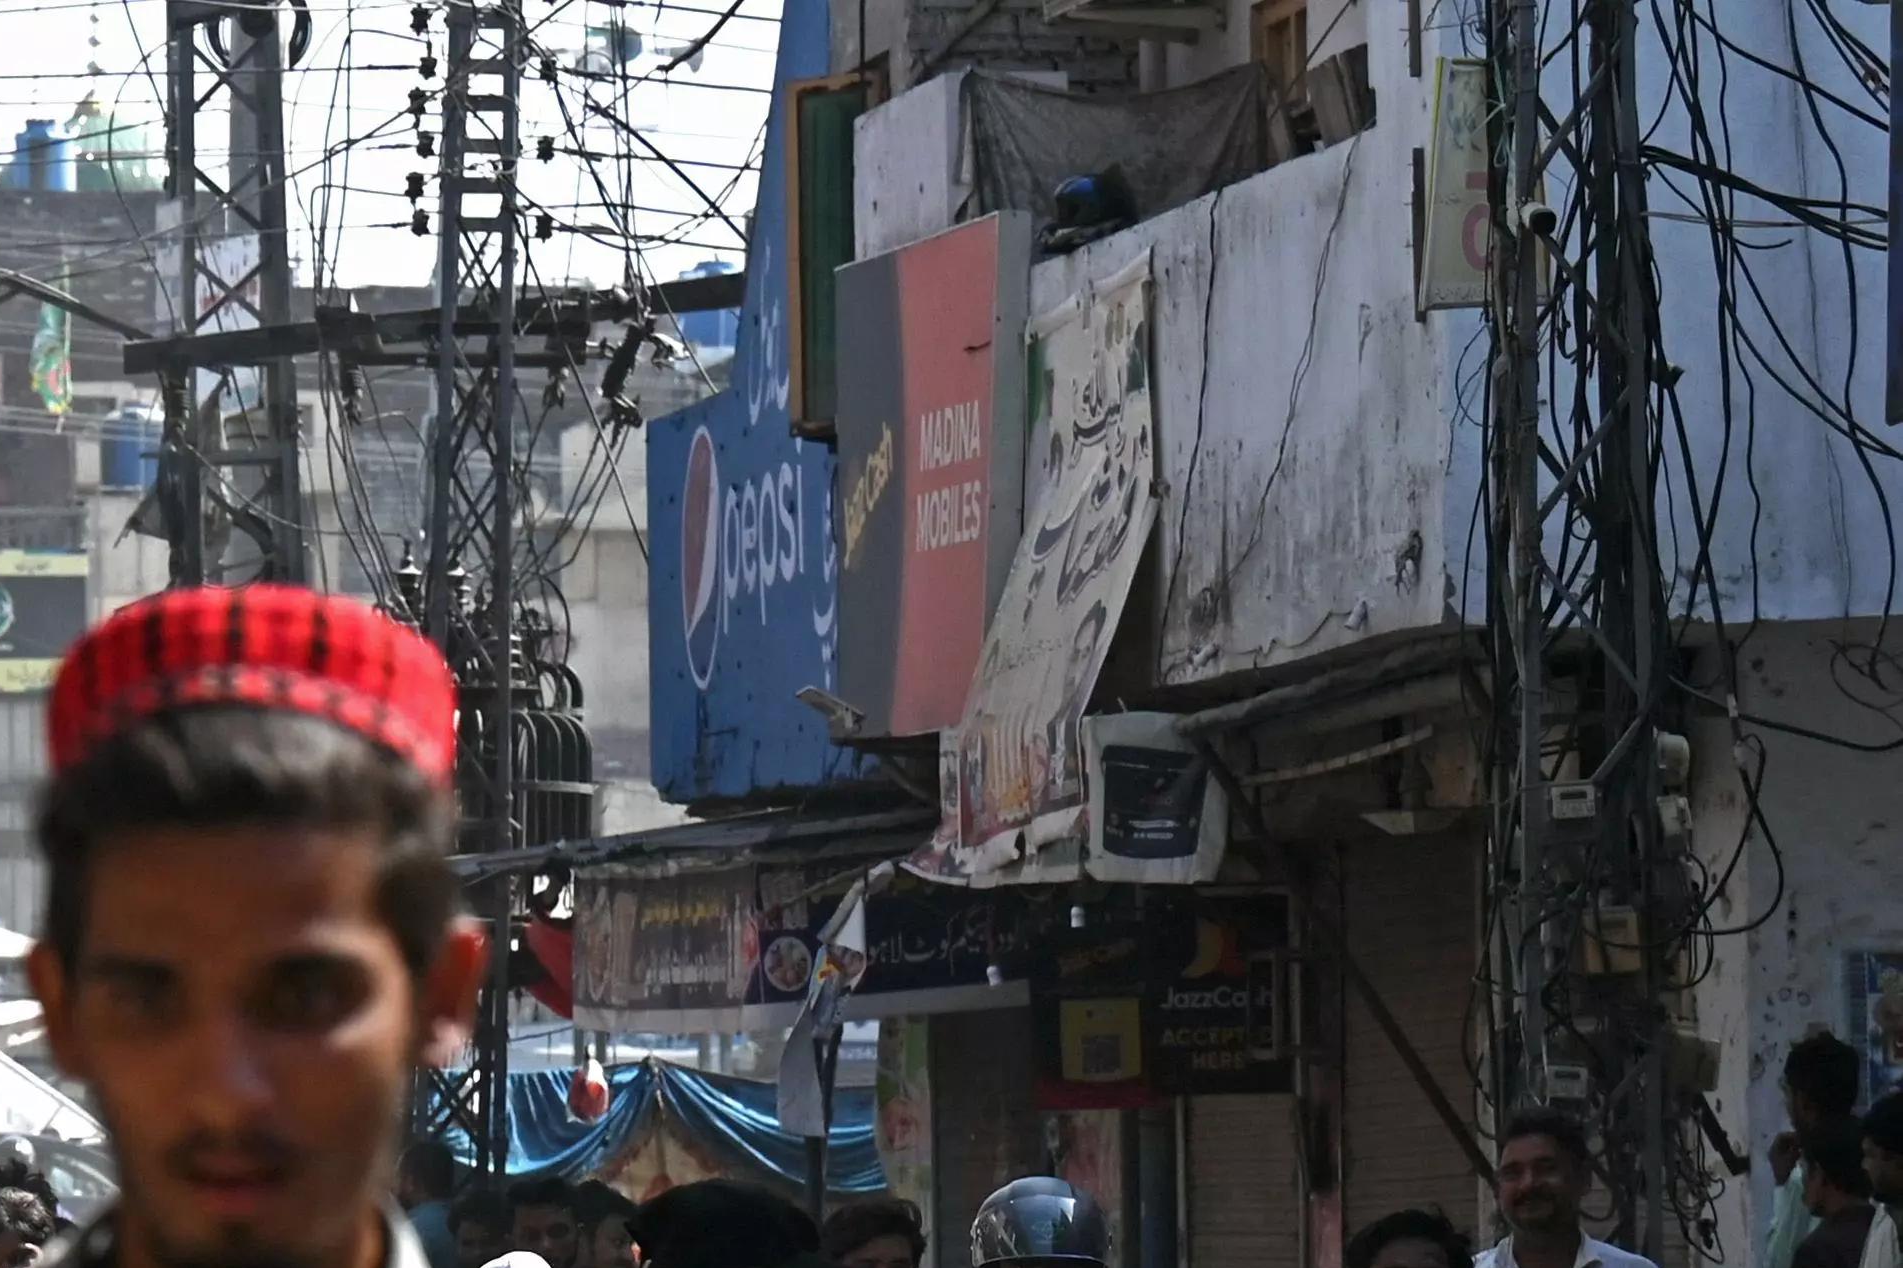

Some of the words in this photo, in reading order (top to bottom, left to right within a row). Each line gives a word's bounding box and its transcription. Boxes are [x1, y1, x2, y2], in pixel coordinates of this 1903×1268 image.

[919, 400, 981, 471] MADINA
[722, 437, 804, 635] pepsi
[915, 480, 981, 552] MOBILES
[1159, 985, 1273, 1010] JazzCah
